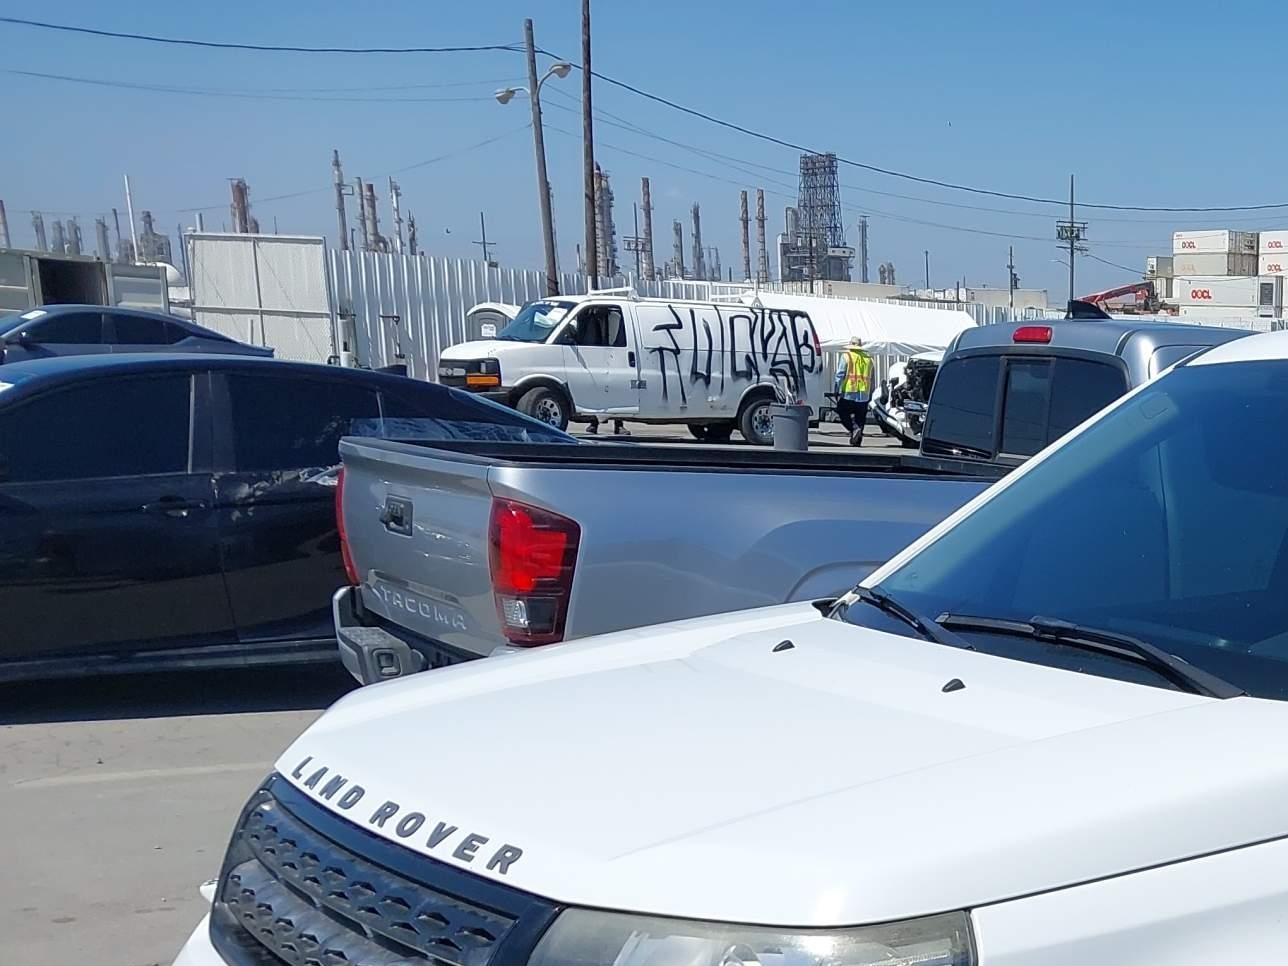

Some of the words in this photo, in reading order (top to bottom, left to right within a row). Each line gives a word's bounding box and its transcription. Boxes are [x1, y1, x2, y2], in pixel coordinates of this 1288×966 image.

[1191, 289, 1213, 299] OOCL
[380, 586, 467, 630] TACOMA
[291, 756, 366, 810] LAND
[369, 800, 524, 876] ROVER
